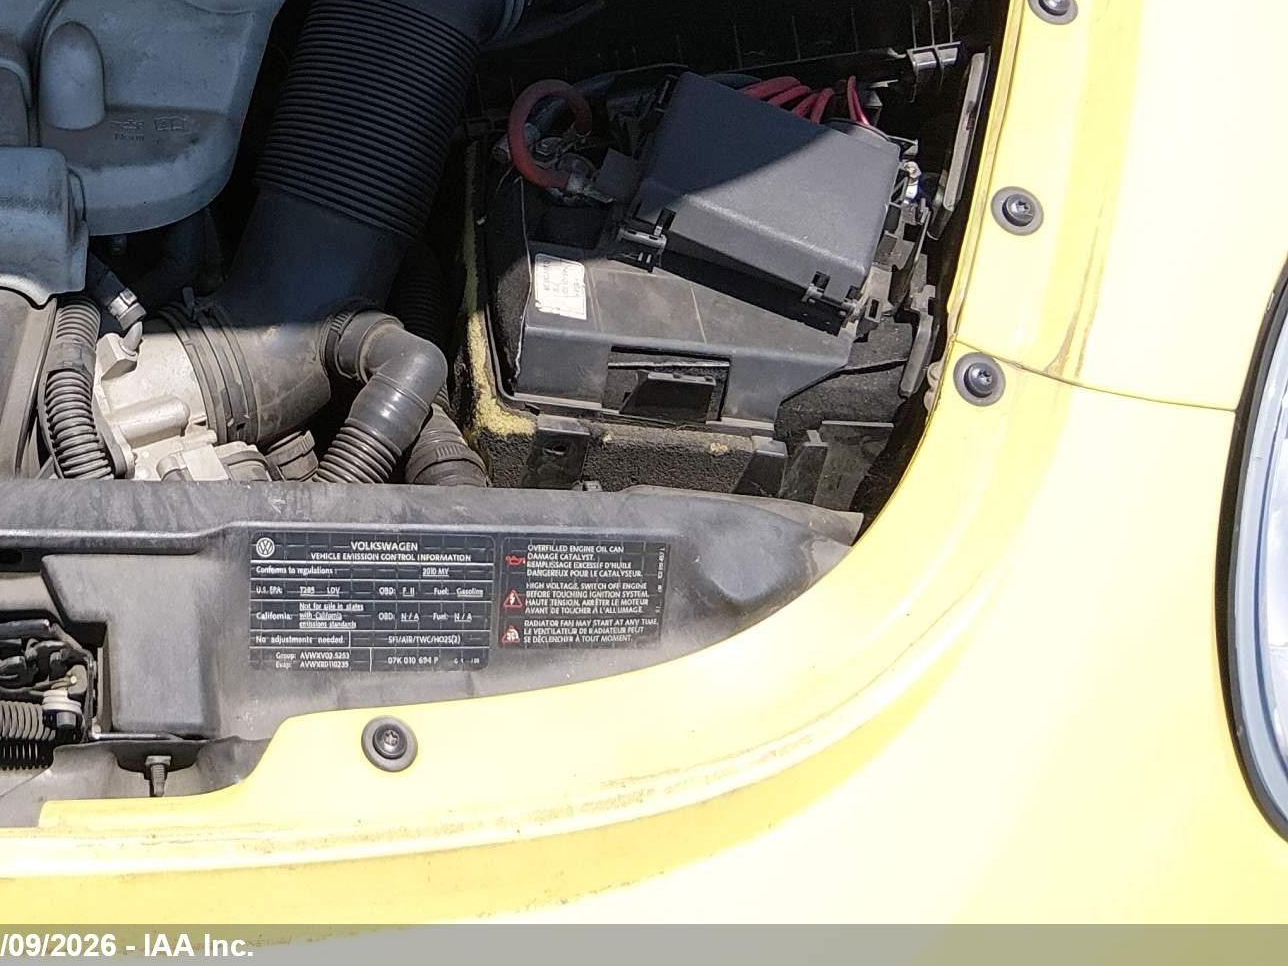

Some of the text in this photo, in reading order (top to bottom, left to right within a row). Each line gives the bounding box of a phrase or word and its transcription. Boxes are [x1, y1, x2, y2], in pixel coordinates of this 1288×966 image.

[351, 541, 418, 551] VOLKSWAGEN
[527, 544, 624, 553] OVERFILLED ENGINE OIL CAN
[380, 553, 415, 561] CONTROL
[417, 554, 472, 562] INFORMATION
[527, 552, 559, 560] DAMAGE
[526, 560, 632, 569] REMPLISSAGE EXCESSIF D'HUILE
[255, 565, 287, 574] Conforms
[288, 566, 296, 574] to
[526, 569, 569, 577] DANGEREUX
[569, 569, 589, 577] POUR
[590, 569, 598, 577] LE
[525, 582, 545, 590] HIGH
[580, 582, 607, 590] SWITCH
[607, 582, 621, 590] OFF
[622, 582, 647, 590] ENGINE
[456, 587, 484, 596] Gasoline
[525, 590, 551, 598] BEFORE
[552, 590, 588, 599] TOUCHING
[589, 590, 621, 598] IGNITION
[299, 602, 312, 610] Not
[313, 602, 322, 610] for
[345, 603, 364, 611] states
[525, 598, 548, 606] HAUTE
[611, 598, 620, 606] LE
[620, 598, 649, 606] MOTEUR
[524, 606, 548, 614] AVANT
[550, 606, 560, 614] DE
[561, 606, 591, 614] TOUCHER
[524, 619, 559, 627] RADIATOR
[560, 619, 574, 627] FAN
[575, 619, 592, 627] MAY
[592, 619, 613, 627] START
[624, 618, 640, 626] ANY
[523, 626, 644, 635] LE VENTILATEUR DE RADIATEUR PEUT
[255, 635, 267, 643] No
[270, 635, 313, 645] adjustments
[523, 635, 532, 643] SE
[581, 635, 600, 643] TOUT
[387, 656, 439, 665] 07K 010 694 P
